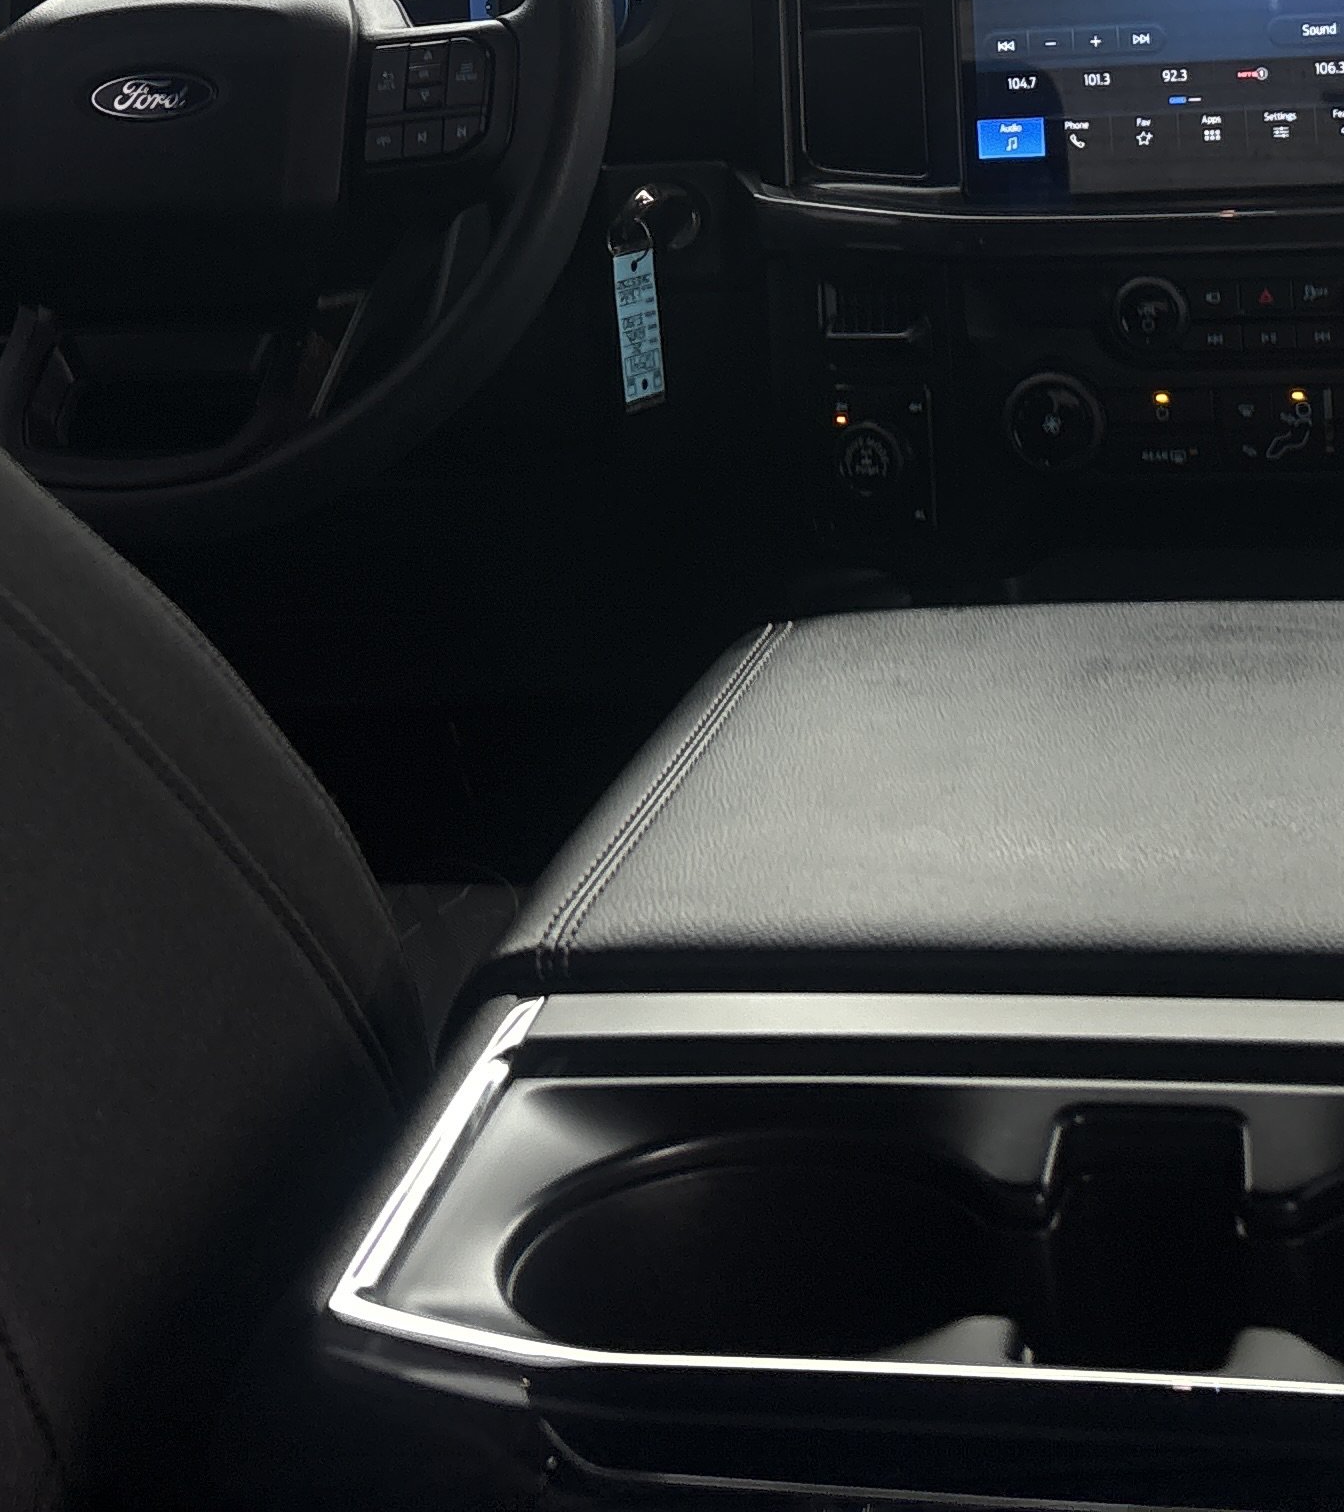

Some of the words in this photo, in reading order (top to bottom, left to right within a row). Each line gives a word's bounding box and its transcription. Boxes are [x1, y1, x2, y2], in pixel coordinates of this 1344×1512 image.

[1301, 22, 1337, 37] Sound
[1083, 72, 1111, 87] 101.3
[1161, 68, 1188, 83] 92.3
[1007, 76, 1037, 90] 104.7
[112, 79, 188, 111] Ford
[1136, 117, 1152, 127] Fav
[1201, 114, 1222, 125] Apps
[1263, 111, 1297, 122] Settings
[1064, 120, 1090, 130] Phone
